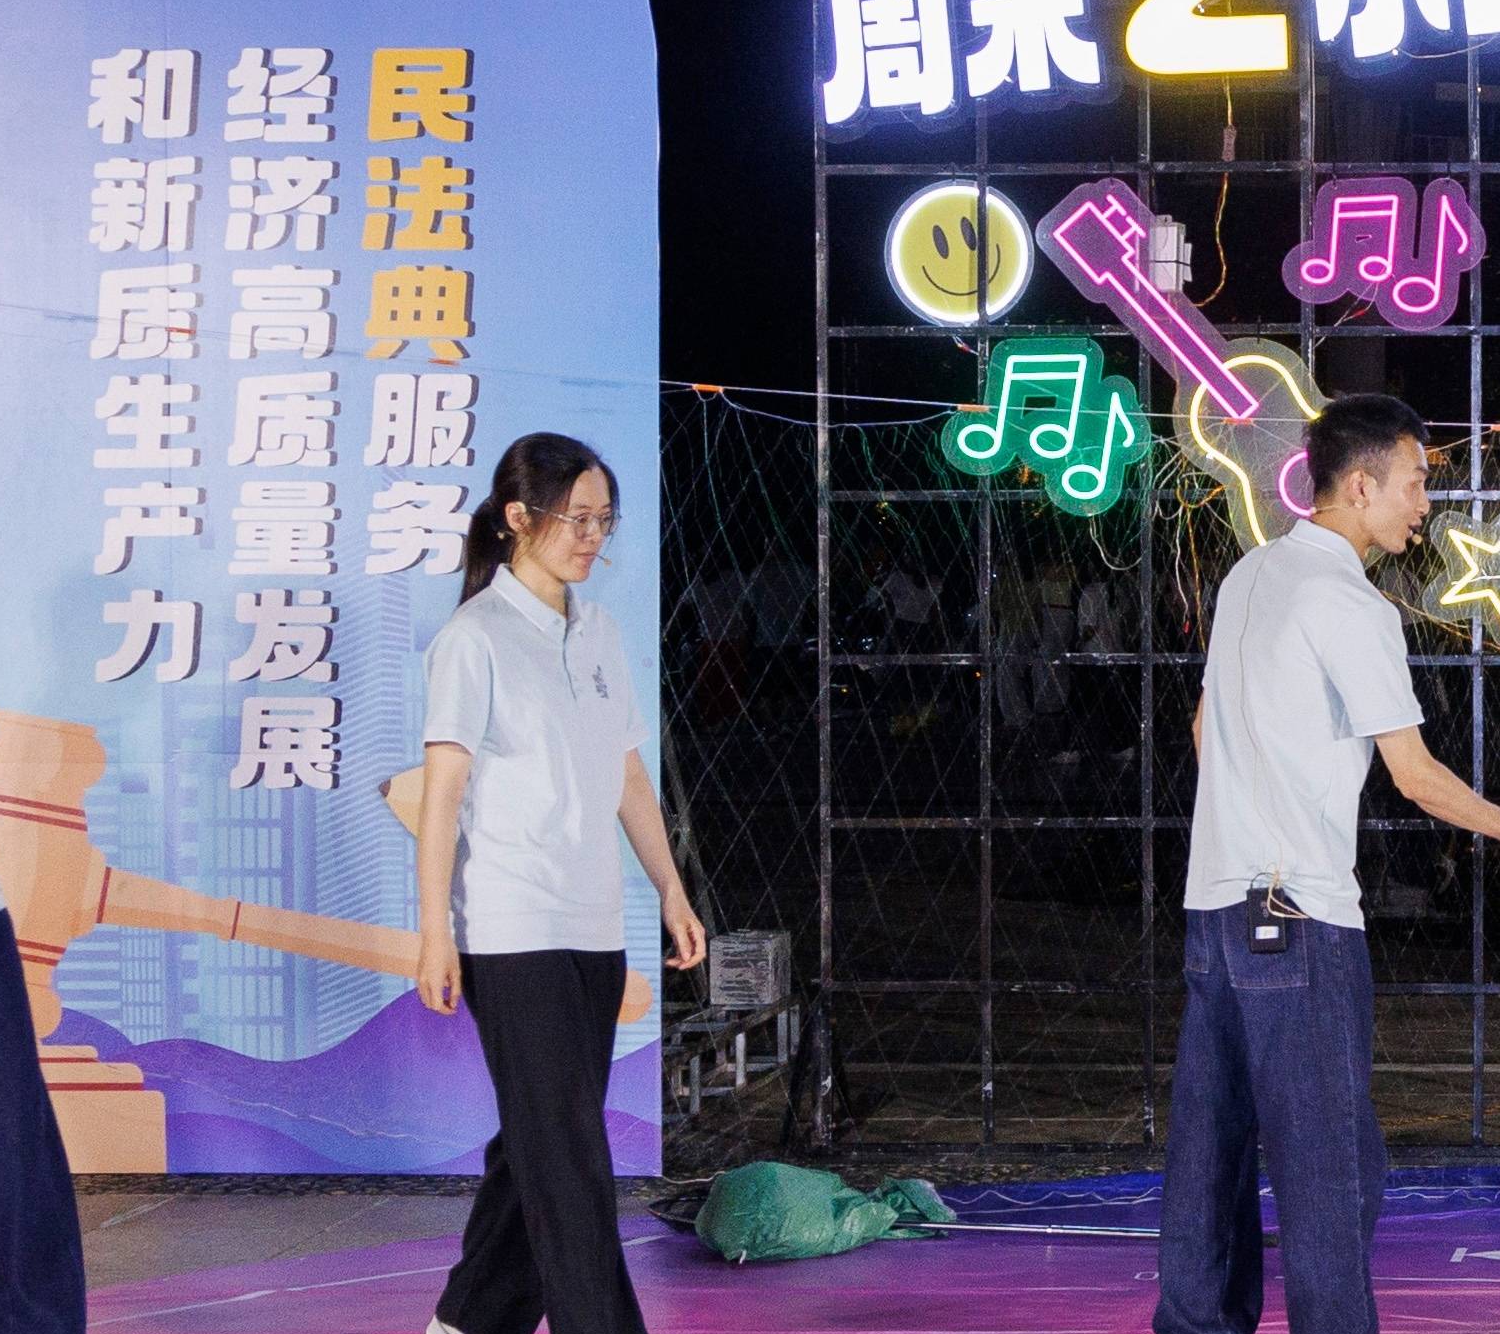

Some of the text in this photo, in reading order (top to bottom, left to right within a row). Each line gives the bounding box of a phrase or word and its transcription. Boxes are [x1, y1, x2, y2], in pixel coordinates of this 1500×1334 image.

[87, 47, 203, 683] 和新质生产力
[224, 47, 342, 791] 经济高质量发展
[362, 46, 478, 576] 民法典服务
